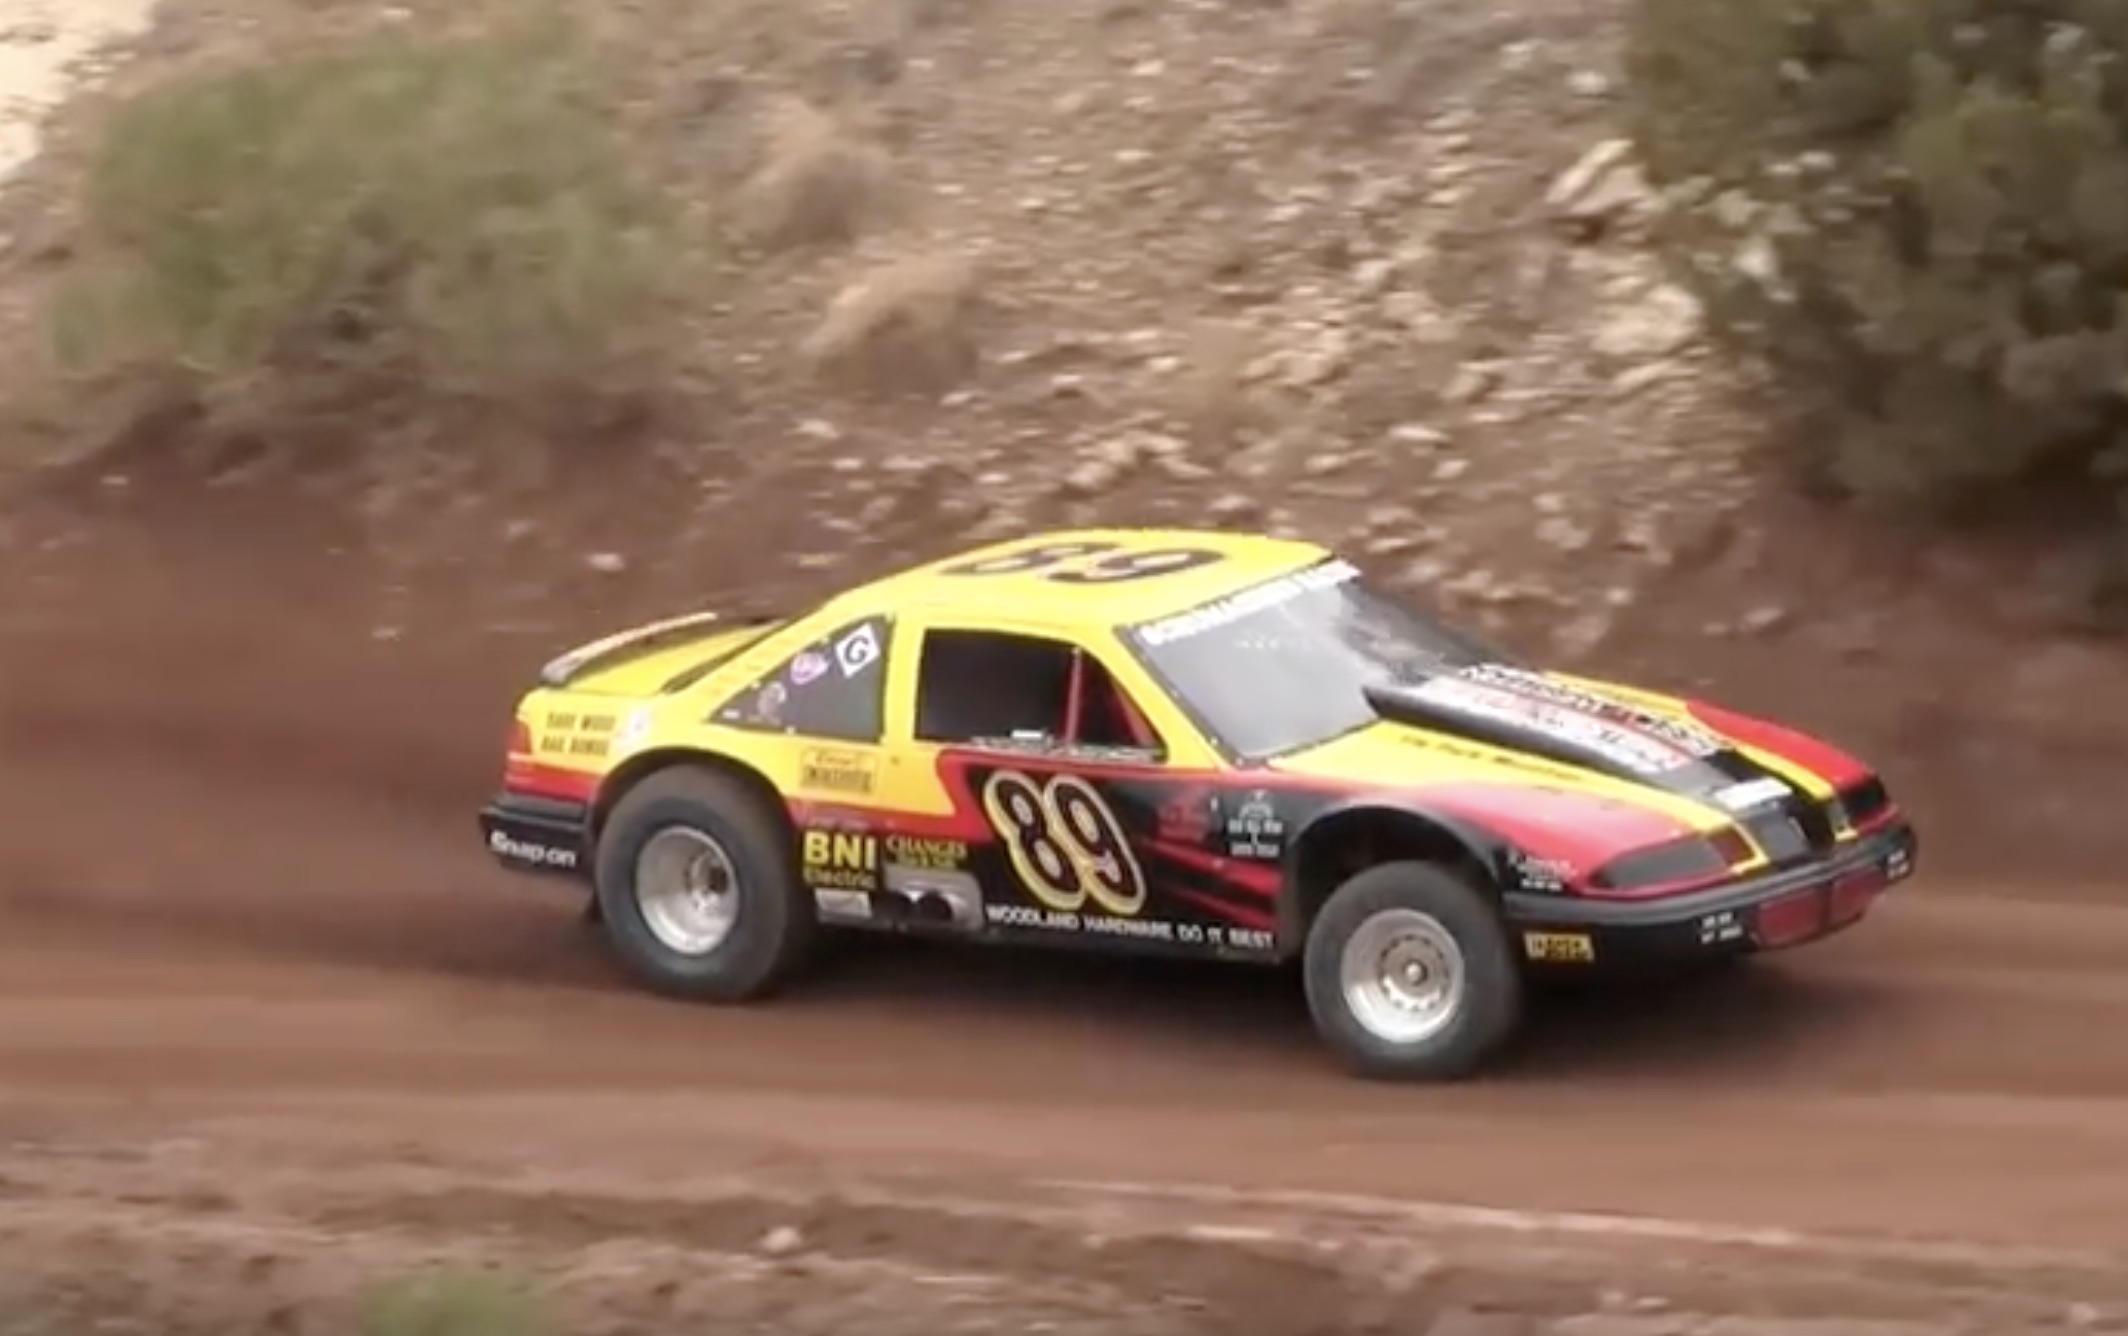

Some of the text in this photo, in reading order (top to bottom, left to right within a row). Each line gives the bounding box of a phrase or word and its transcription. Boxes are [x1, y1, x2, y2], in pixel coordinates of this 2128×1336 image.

[937, 542, 1226, 583] 89
[844, 634, 870, 666] G
[803, 830, 877, 870] BNI
[983, 770, 1146, 914] 89
[803, 867, 877, 890] Electric
[985, 903, 1079, 930] WOODLAND
[1083, 915, 1172, 940] HARDWARE
[1177, 924, 1202, 942] DO
[1228, 926, 1275, 949] BEST
